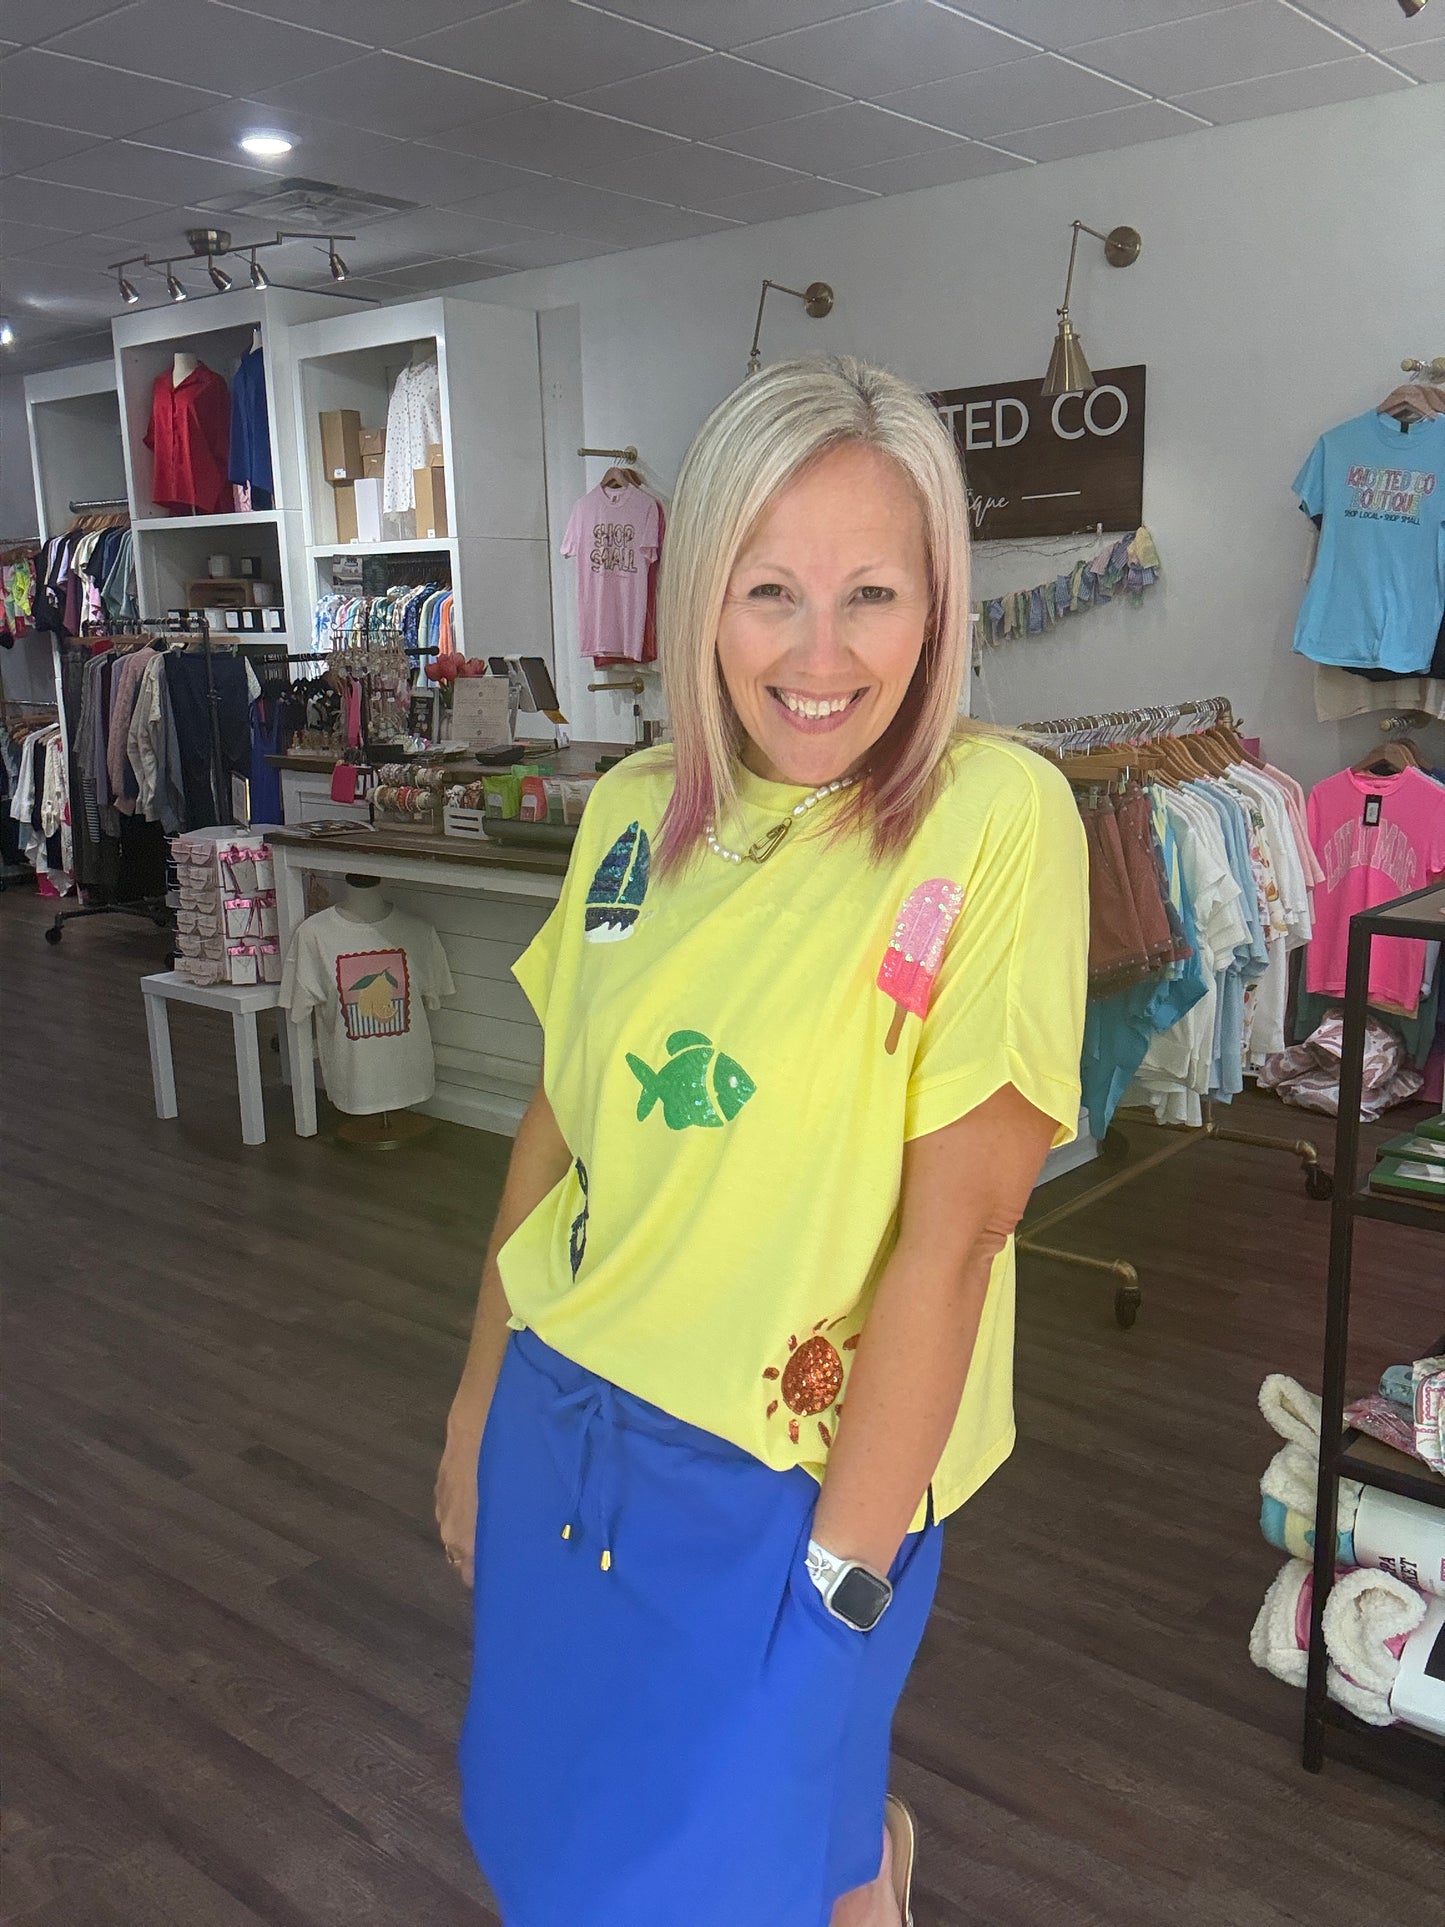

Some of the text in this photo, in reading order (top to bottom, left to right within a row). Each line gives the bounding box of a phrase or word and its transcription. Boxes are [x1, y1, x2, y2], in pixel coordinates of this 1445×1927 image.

[1051, 384, 1129, 440] CO
[1346, 465, 1437, 496] KNOTTED CO
[1344, 510, 1358, 518] SHOP
[1360, 511, 1380, 520] LOCAL
[1384, 513, 1400, 521] SHOP
[1350, 488, 1420, 516] BOUTIQUE
[593, 523, 635, 548] SHOP
[590, 547, 637, 573] SMALL
